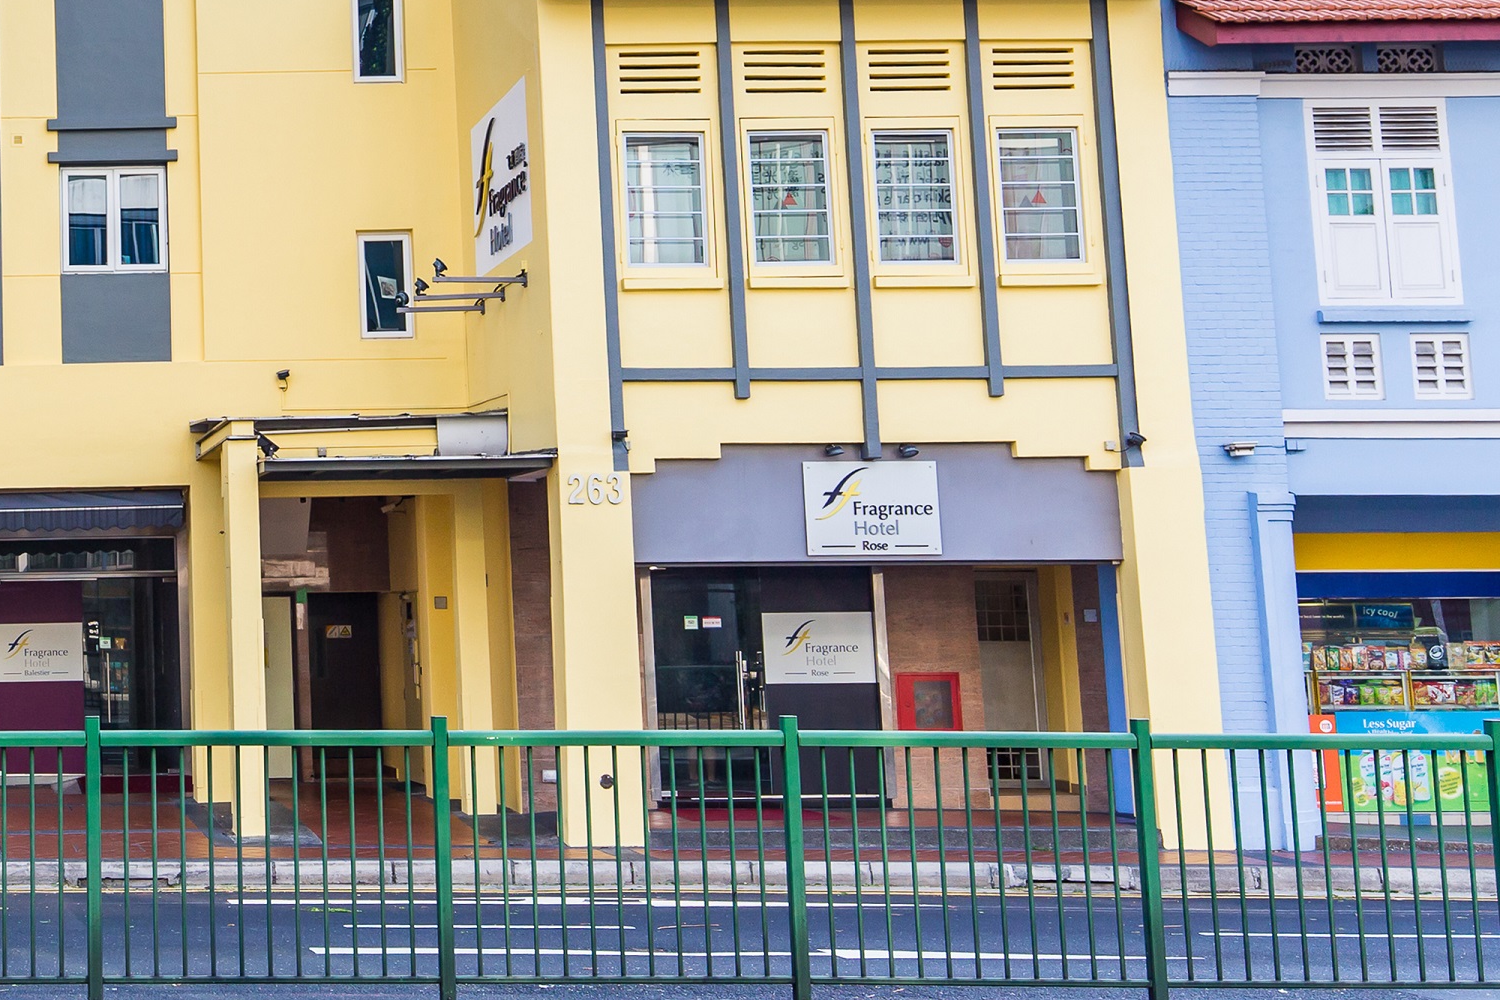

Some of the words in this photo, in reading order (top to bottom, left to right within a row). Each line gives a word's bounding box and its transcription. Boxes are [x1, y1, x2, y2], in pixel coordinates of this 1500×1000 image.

[488, 171, 528, 217] Fragrance
[490, 212, 513, 255] Hotel
[568, 473, 624, 505] 263
[853, 501, 933, 520] Fragrance
[854, 520, 900, 536] Hotel
[862, 541, 889, 551] Rose
[1362, 606, 1376, 617] icy
[1377, 608, 1399, 619] cool
[24, 648, 69, 659] Fragrance
[805, 643, 859, 655] Fragrance
[24, 658, 50, 668] Hotel
[806, 655, 837, 666] Hotel
[811, 669, 829, 677] Rose
[1363, 718, 1385, 728] Less
[1386, 718, 1417, 730] Sugar
